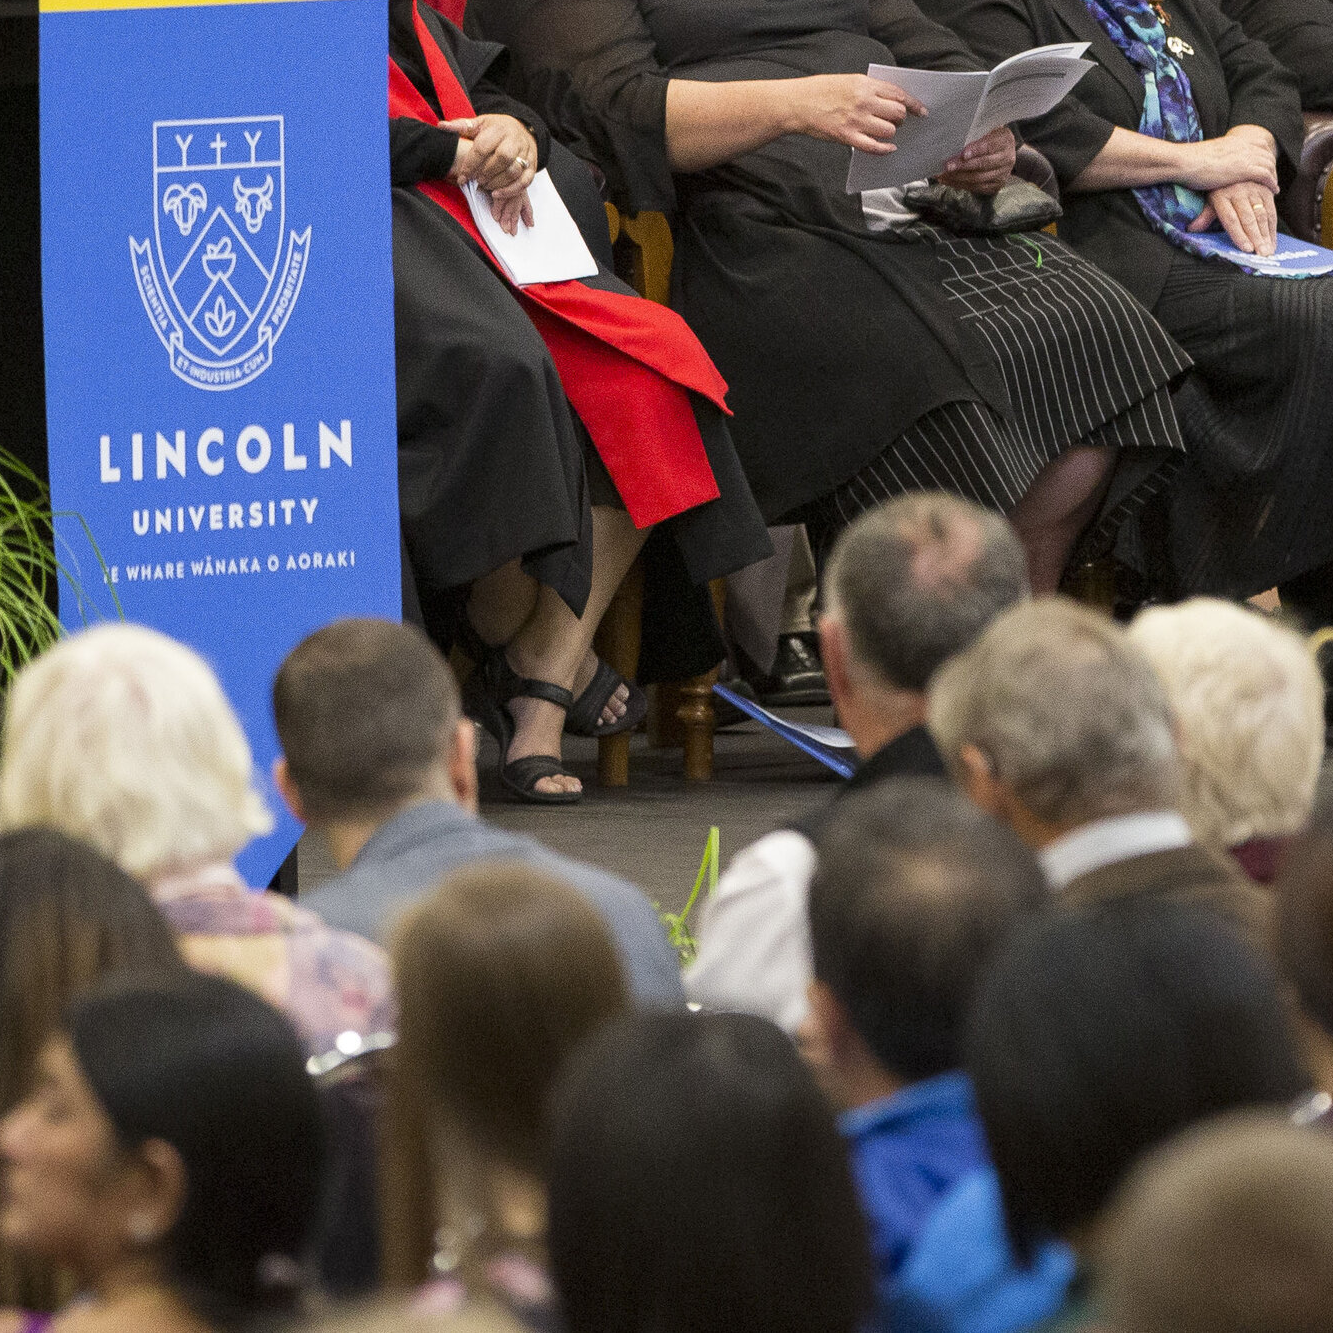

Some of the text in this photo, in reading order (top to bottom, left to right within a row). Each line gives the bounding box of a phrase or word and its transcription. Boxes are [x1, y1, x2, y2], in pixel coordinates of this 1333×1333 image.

[140, 265, 169, 330] SCIENTIA
[271, 252, 303, 325] PROBITATE
[100, 419, 352, 483] LINCOLN
[132, 498, 318, 536] UNIVERSITY
[126, 560, 185, 582] WHARE
[268, 554, 280, 572] O
[286, 550, 356, 570] AORAKI
